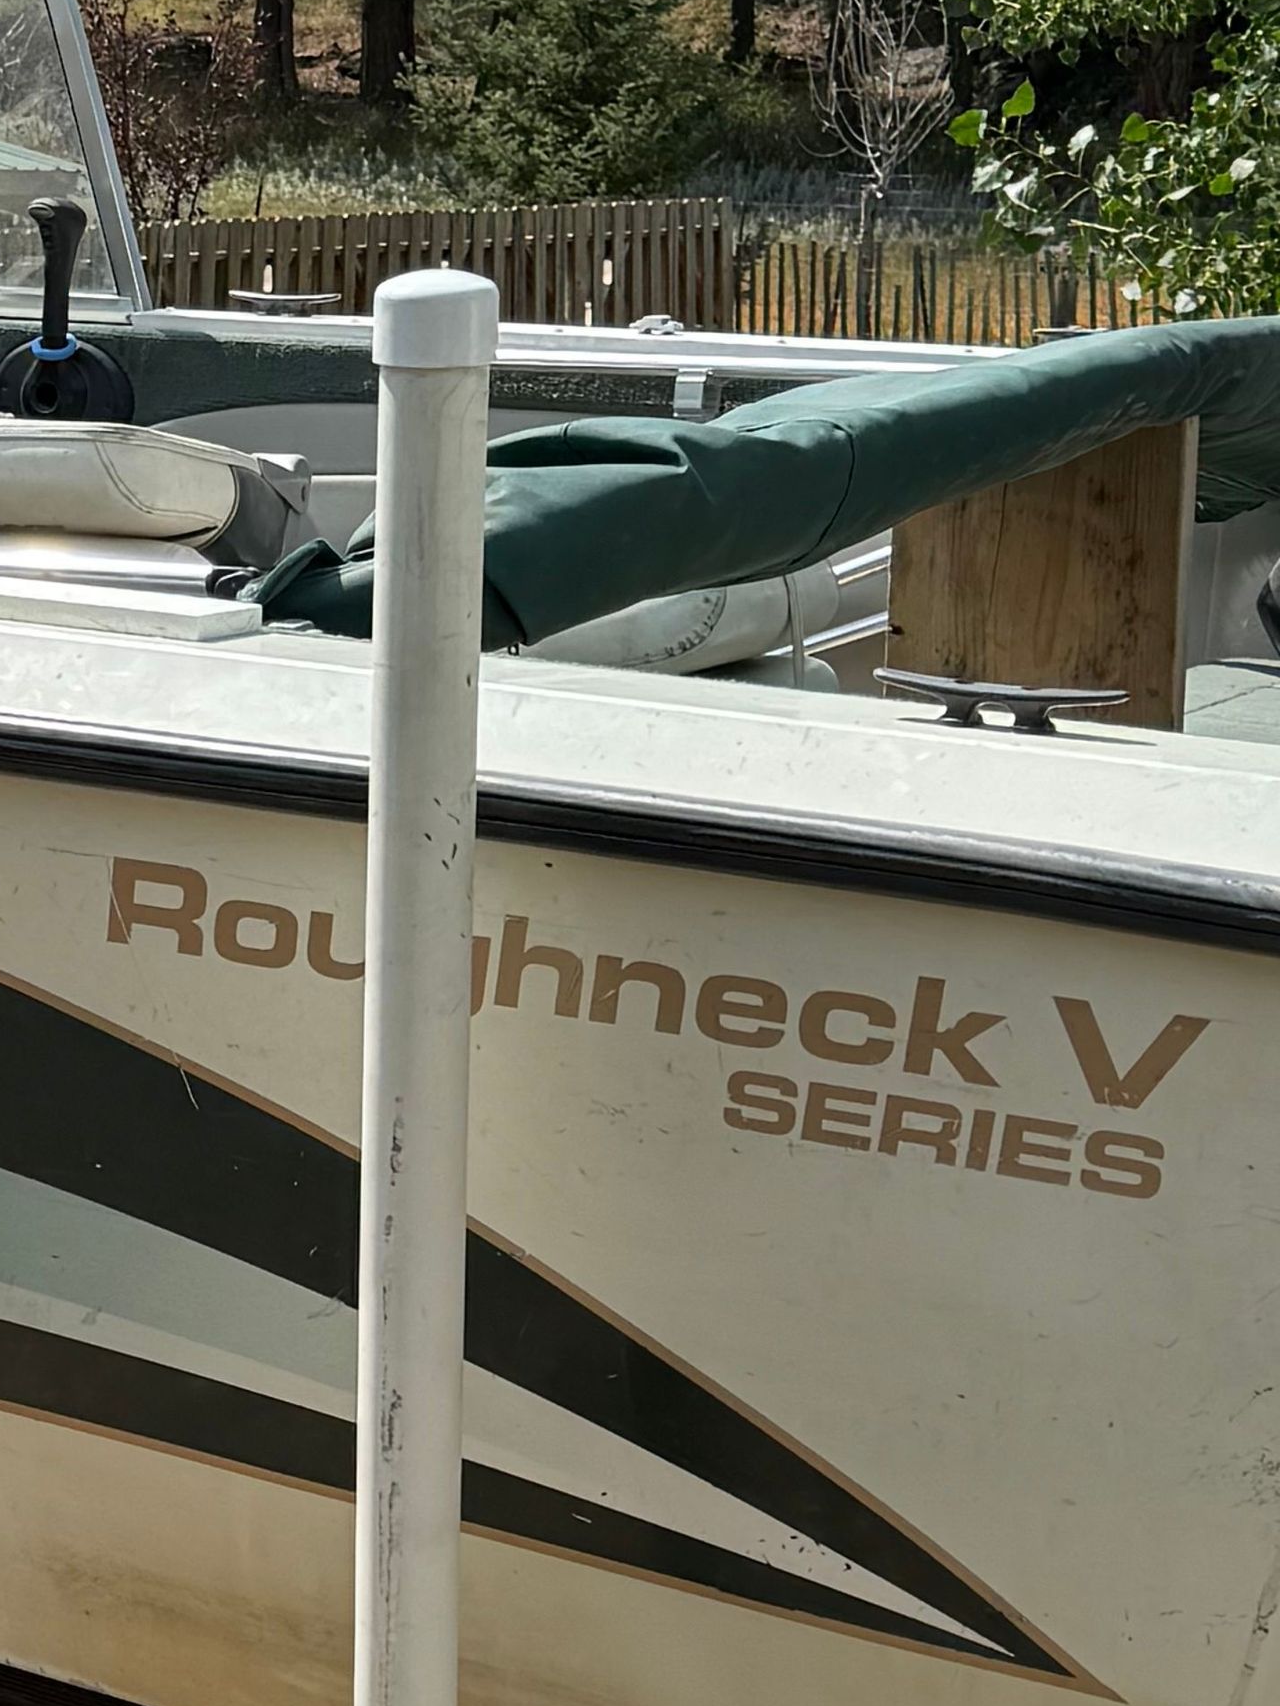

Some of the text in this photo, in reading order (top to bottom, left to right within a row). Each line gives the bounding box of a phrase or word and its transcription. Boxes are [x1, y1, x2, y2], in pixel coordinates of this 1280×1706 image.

[105, 856, 1210, 1110] Rouhneck V
[722, 1069, 1165, 1200] SERIES
